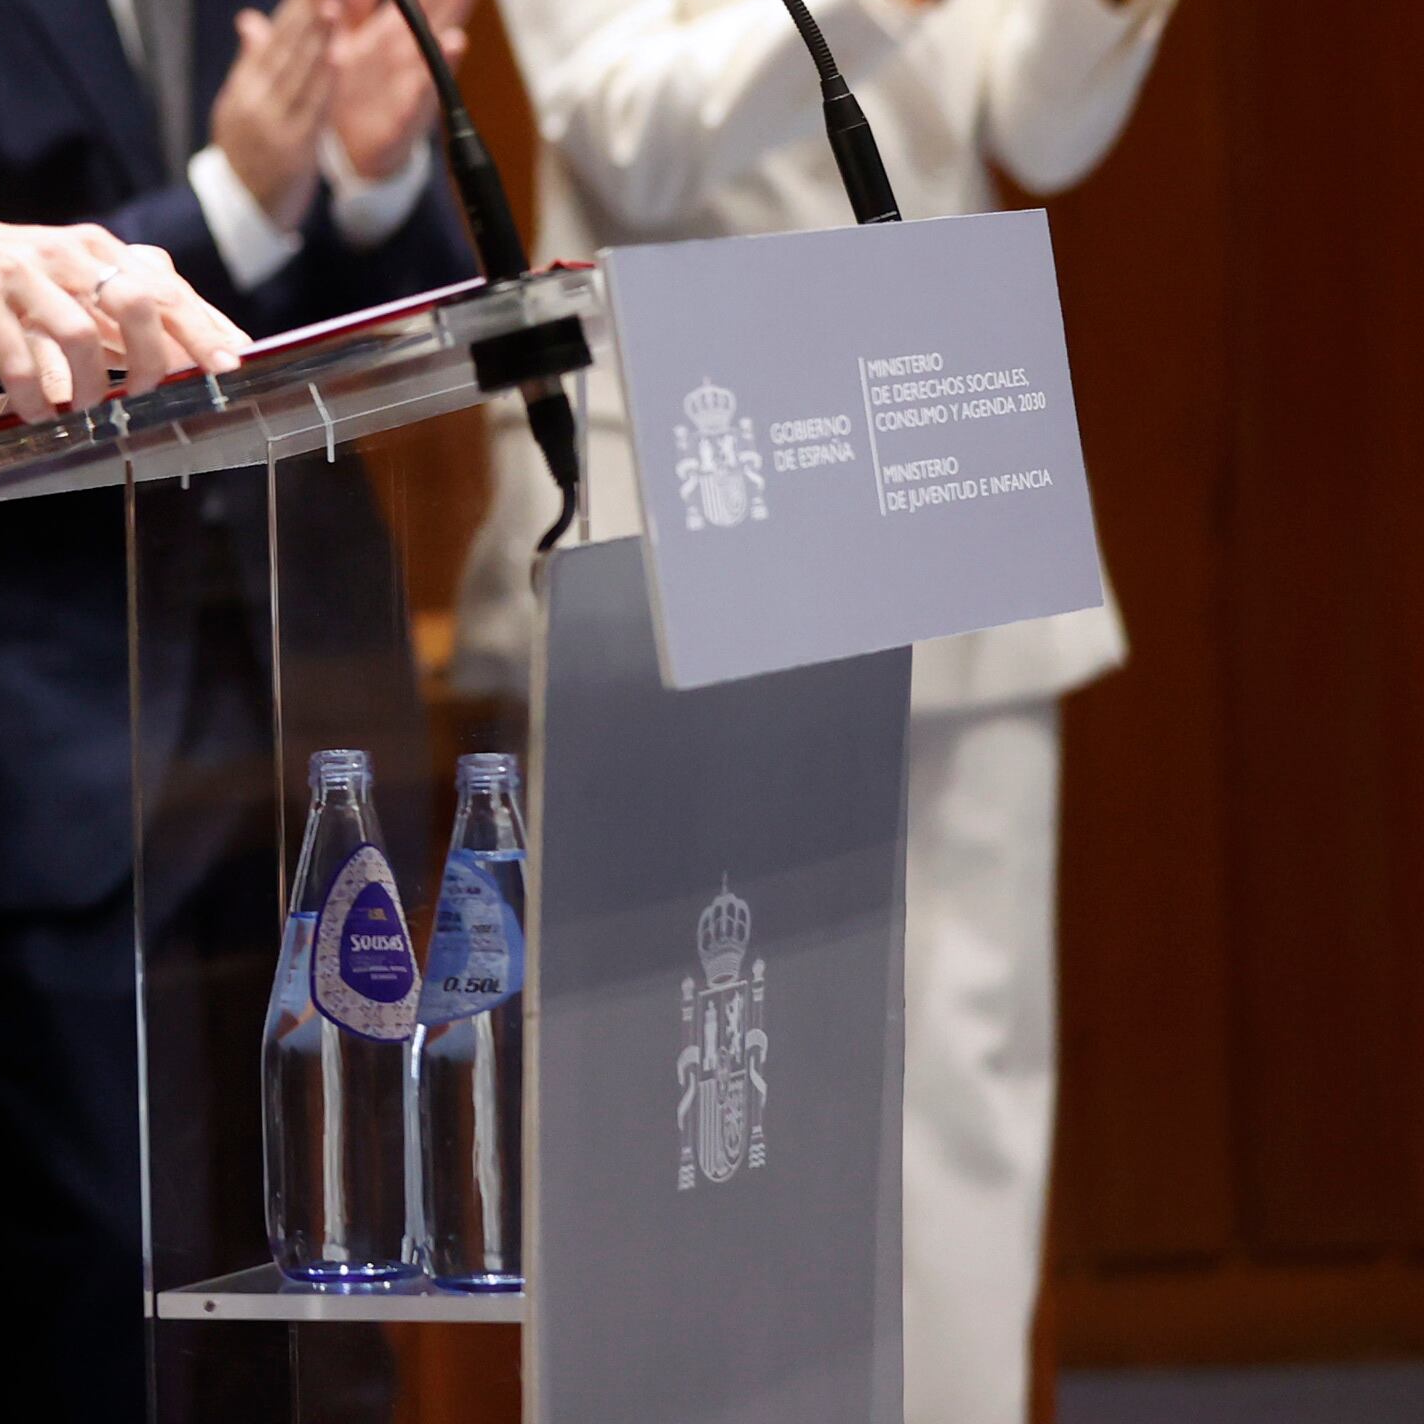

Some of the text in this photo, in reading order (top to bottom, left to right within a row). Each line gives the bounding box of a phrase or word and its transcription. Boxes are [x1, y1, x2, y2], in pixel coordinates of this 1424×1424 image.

[867, 353, 943, 378] MINISTERIO
[871, 368, 1030, 405] DE DERECHOS SOCIALES,
[875, 391, 1046, 432] CONSUMO Y AGENDA 2030
[770, 415, 851, 444] GOBIERNO
[773, 438, 855, 472] DE ESPAÑA
[883, 456, 959, 484] MINISTERIO
[886, 469, 1053, 513] DE JUVENTUD E INFANCIA
